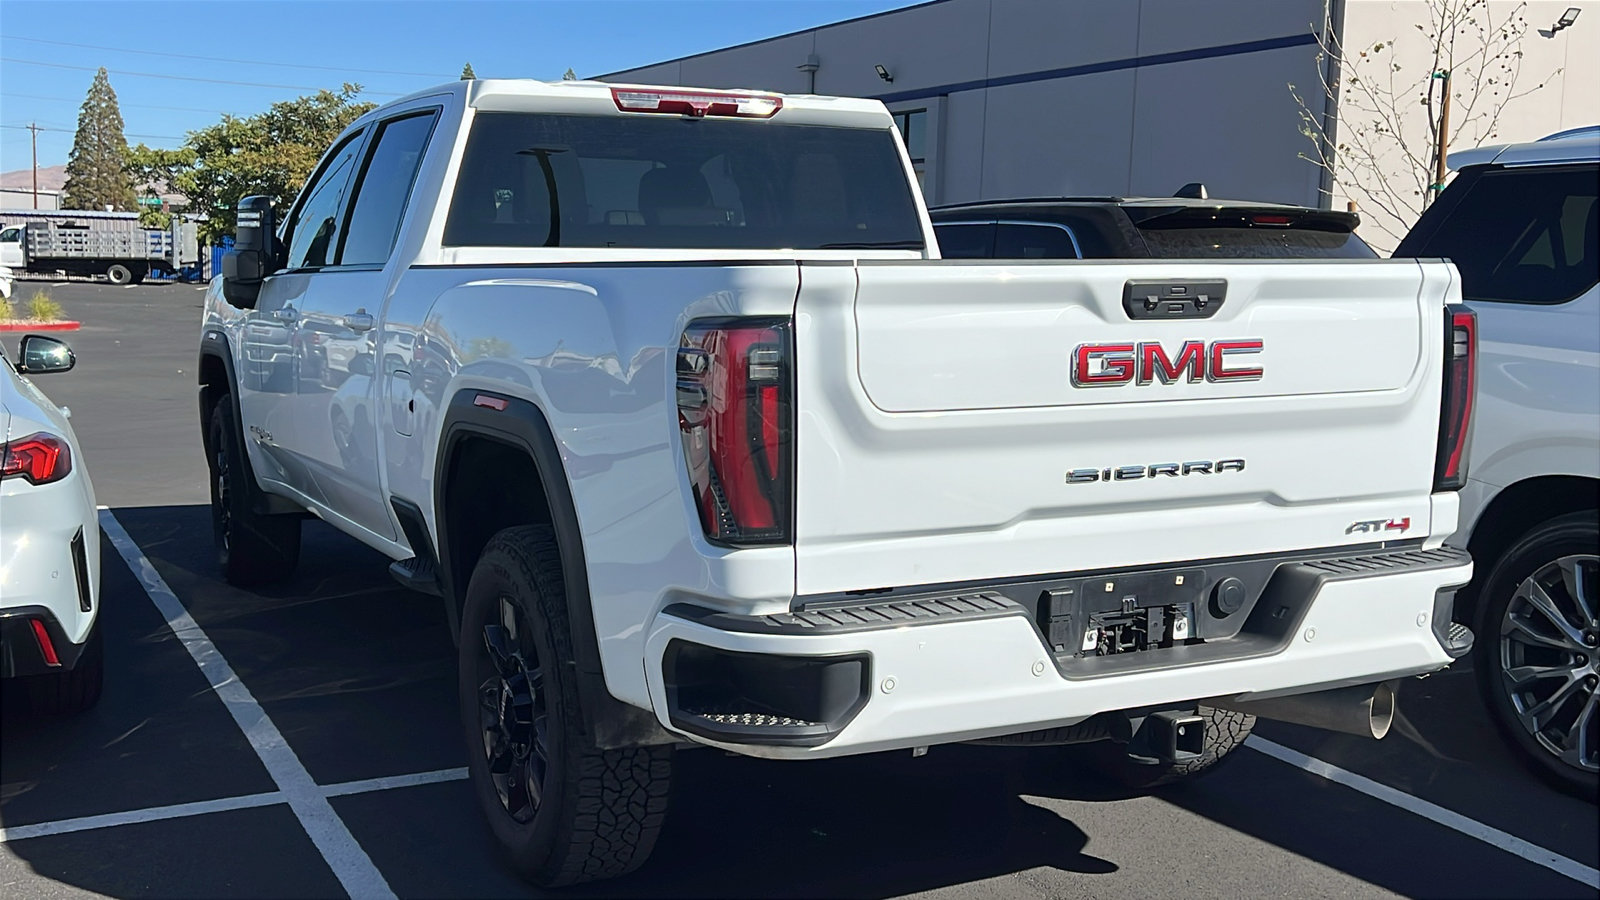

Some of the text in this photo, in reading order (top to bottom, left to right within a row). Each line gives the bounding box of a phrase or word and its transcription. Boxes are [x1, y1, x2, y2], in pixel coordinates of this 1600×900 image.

[1071, 339, 1264, 388] GMC
[1066, 459, 1246, 484] SIERRA
[1345, 517, 1411, 535] AT4
